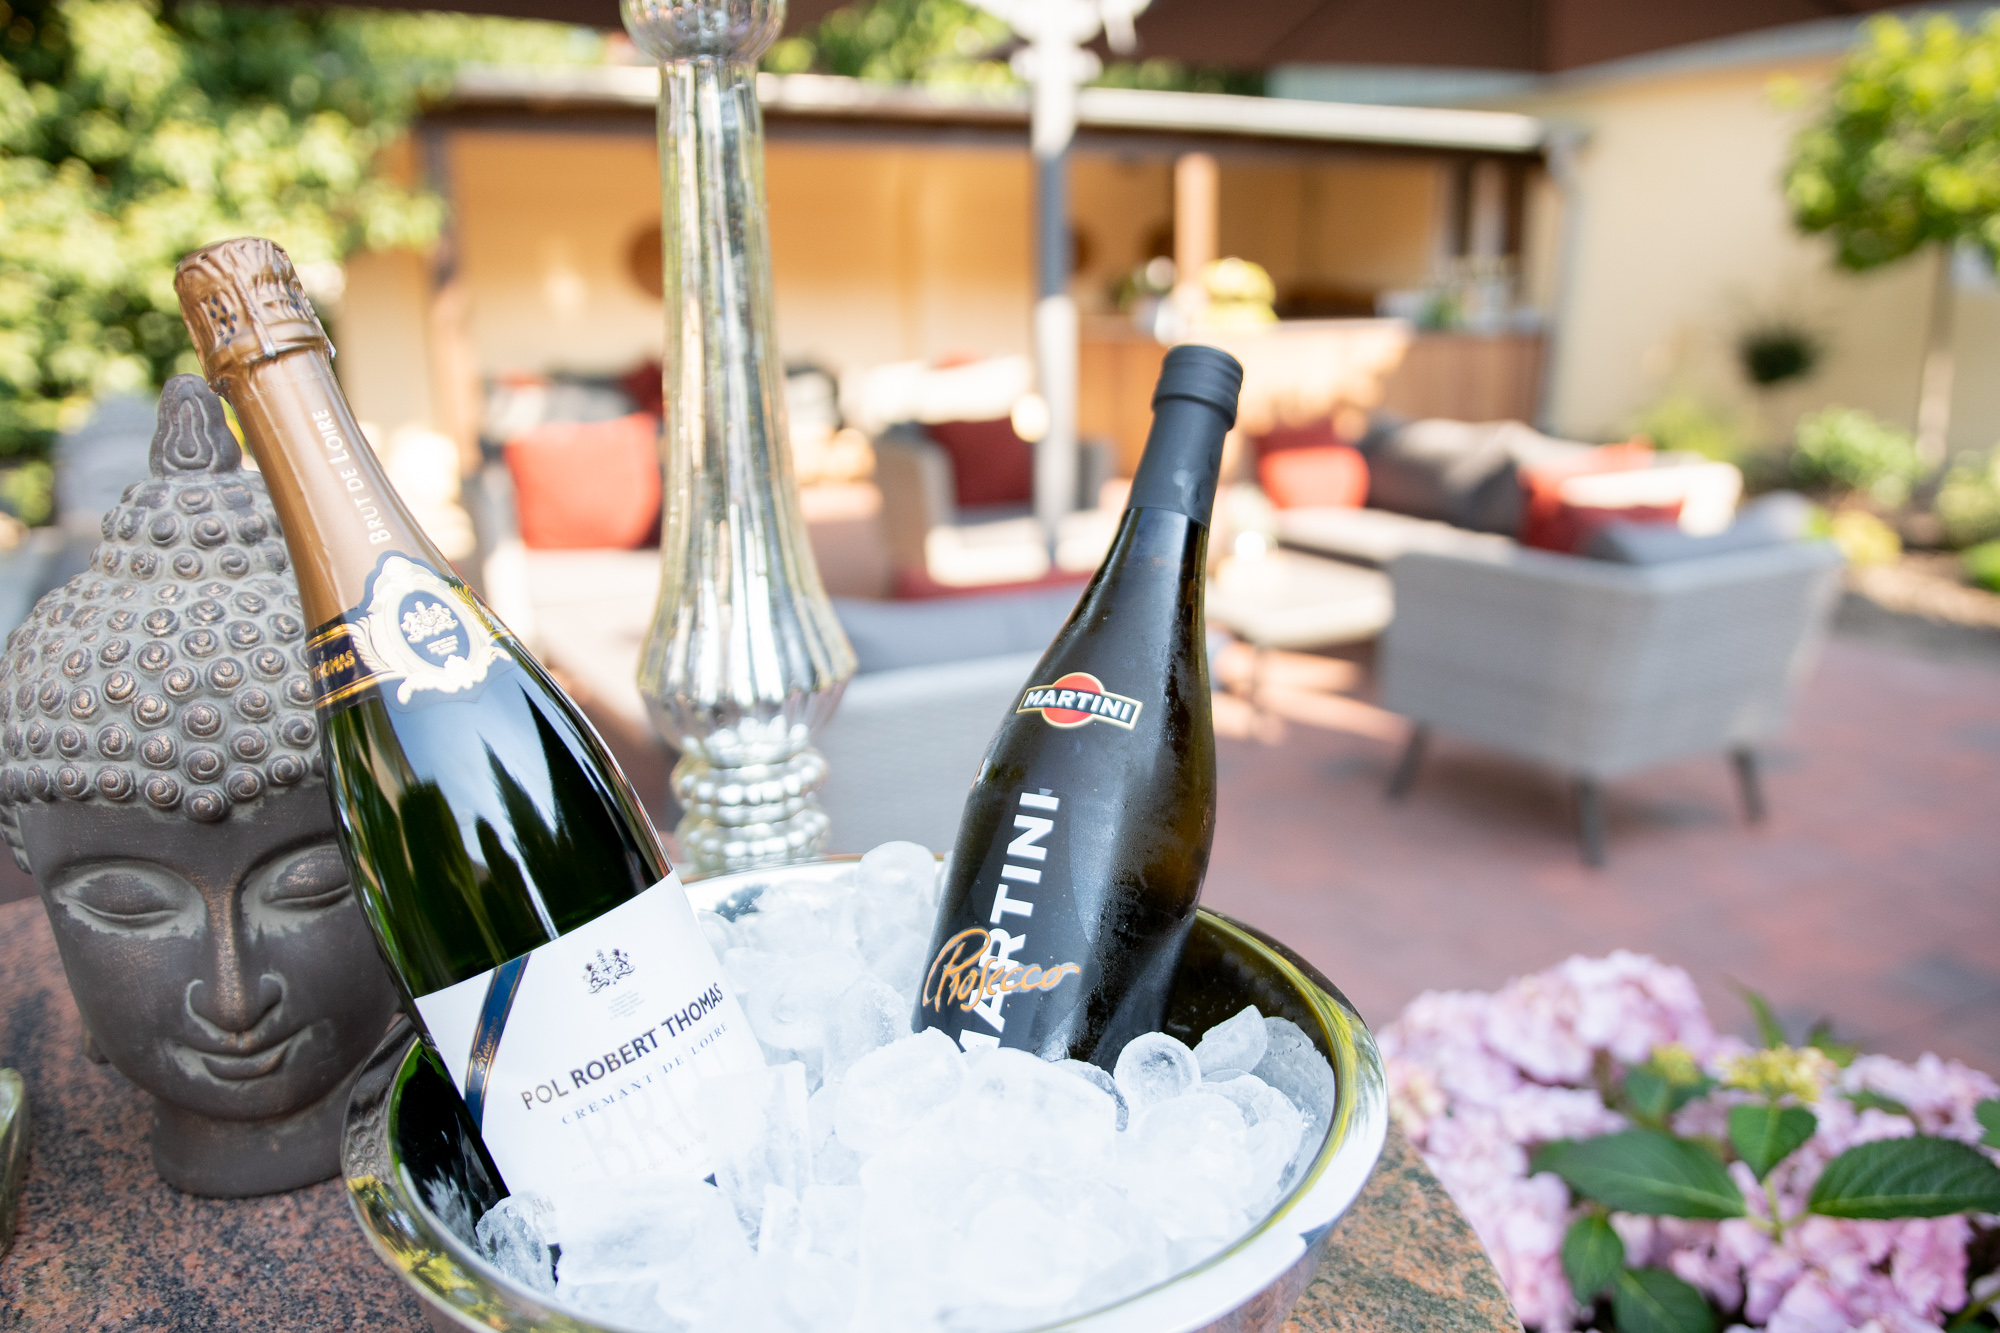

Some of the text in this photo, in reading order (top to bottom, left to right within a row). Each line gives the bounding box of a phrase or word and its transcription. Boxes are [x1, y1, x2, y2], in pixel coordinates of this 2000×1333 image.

[312, 409, 392, 545] BRUT DE LOIRE
[1023, 689, 1132, 720] MARTINI
[923, 928, 1081, 1012] Prosecco
[520, 1079, 569, 1111] POL
[569, 1028, 660, 1090] ROBERT
[660, 982, 724, 1039] THOMAS
[560, 1021, 728, 1126] CREMANT DE LOIRE
